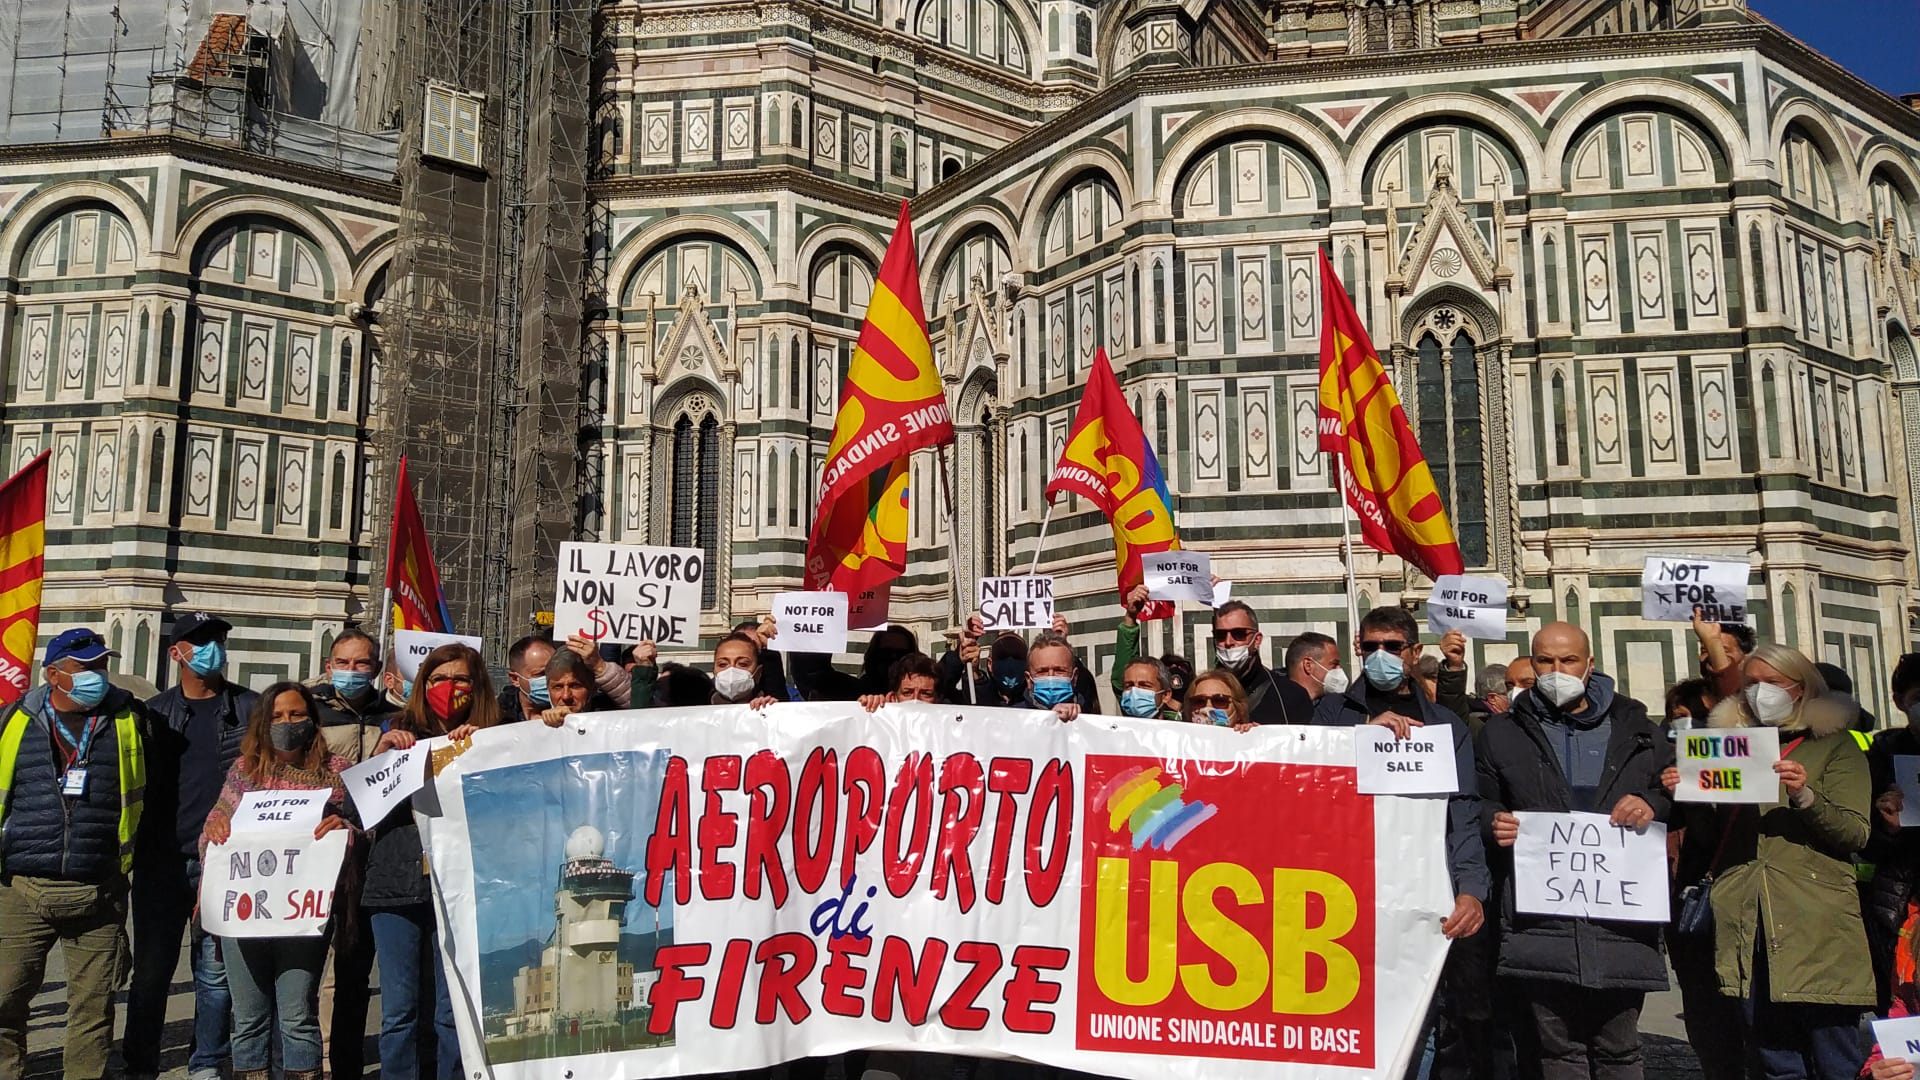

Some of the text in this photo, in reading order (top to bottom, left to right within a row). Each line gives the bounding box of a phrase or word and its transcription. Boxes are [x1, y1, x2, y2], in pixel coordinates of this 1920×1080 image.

[570, 549, 701, 583] IL LAVORO
[1157, 562, 1199, 572] NOT FOR
[1659, 561, 1709, 582] NOT
[982, 579, 1053, 600] NOT FOR
[1167, 575, 1193, 585] SALE
[563, 580, 671, 609] NON SI
[1440, 589, 1488, 604] NOT FOR
[1675, 583, 1718, 604] FOR
[784, 606, 835, 616] NOT FOR
[1446, 607, 1476, 619] SALE
[793, 623, 824, 633] SALE
[1374, 742, 1434, 753] NOT FOR
[1688, 736, 1750, 758] NOT ON
[365, 753, 410, 787] NOT FOR
[1387, 761, 1424, 772] SALE
[382, 774, 402, 798] SALE
[1699, 768, 1741, 790] SALE
[253, 798, 310, 810] NOT FOR
[257, 811, 293, 821] SALE
[644, 746, 1073, 914] AEROPORTO
[230, 849, 300, 880] NOT
[1550, 852, 1611, 873] FOR
[1546, 877, 1642, 906] SALE
[223, 889, 272, 922] FOR
[810, 873, 878, 940] di
[1094, 857, 1360, 1015] USB
[648, 932, 1070, 1035] FIRENZE
[1090, 1013, 1361, 1053] UNIONE SINDACALE DI BASE
